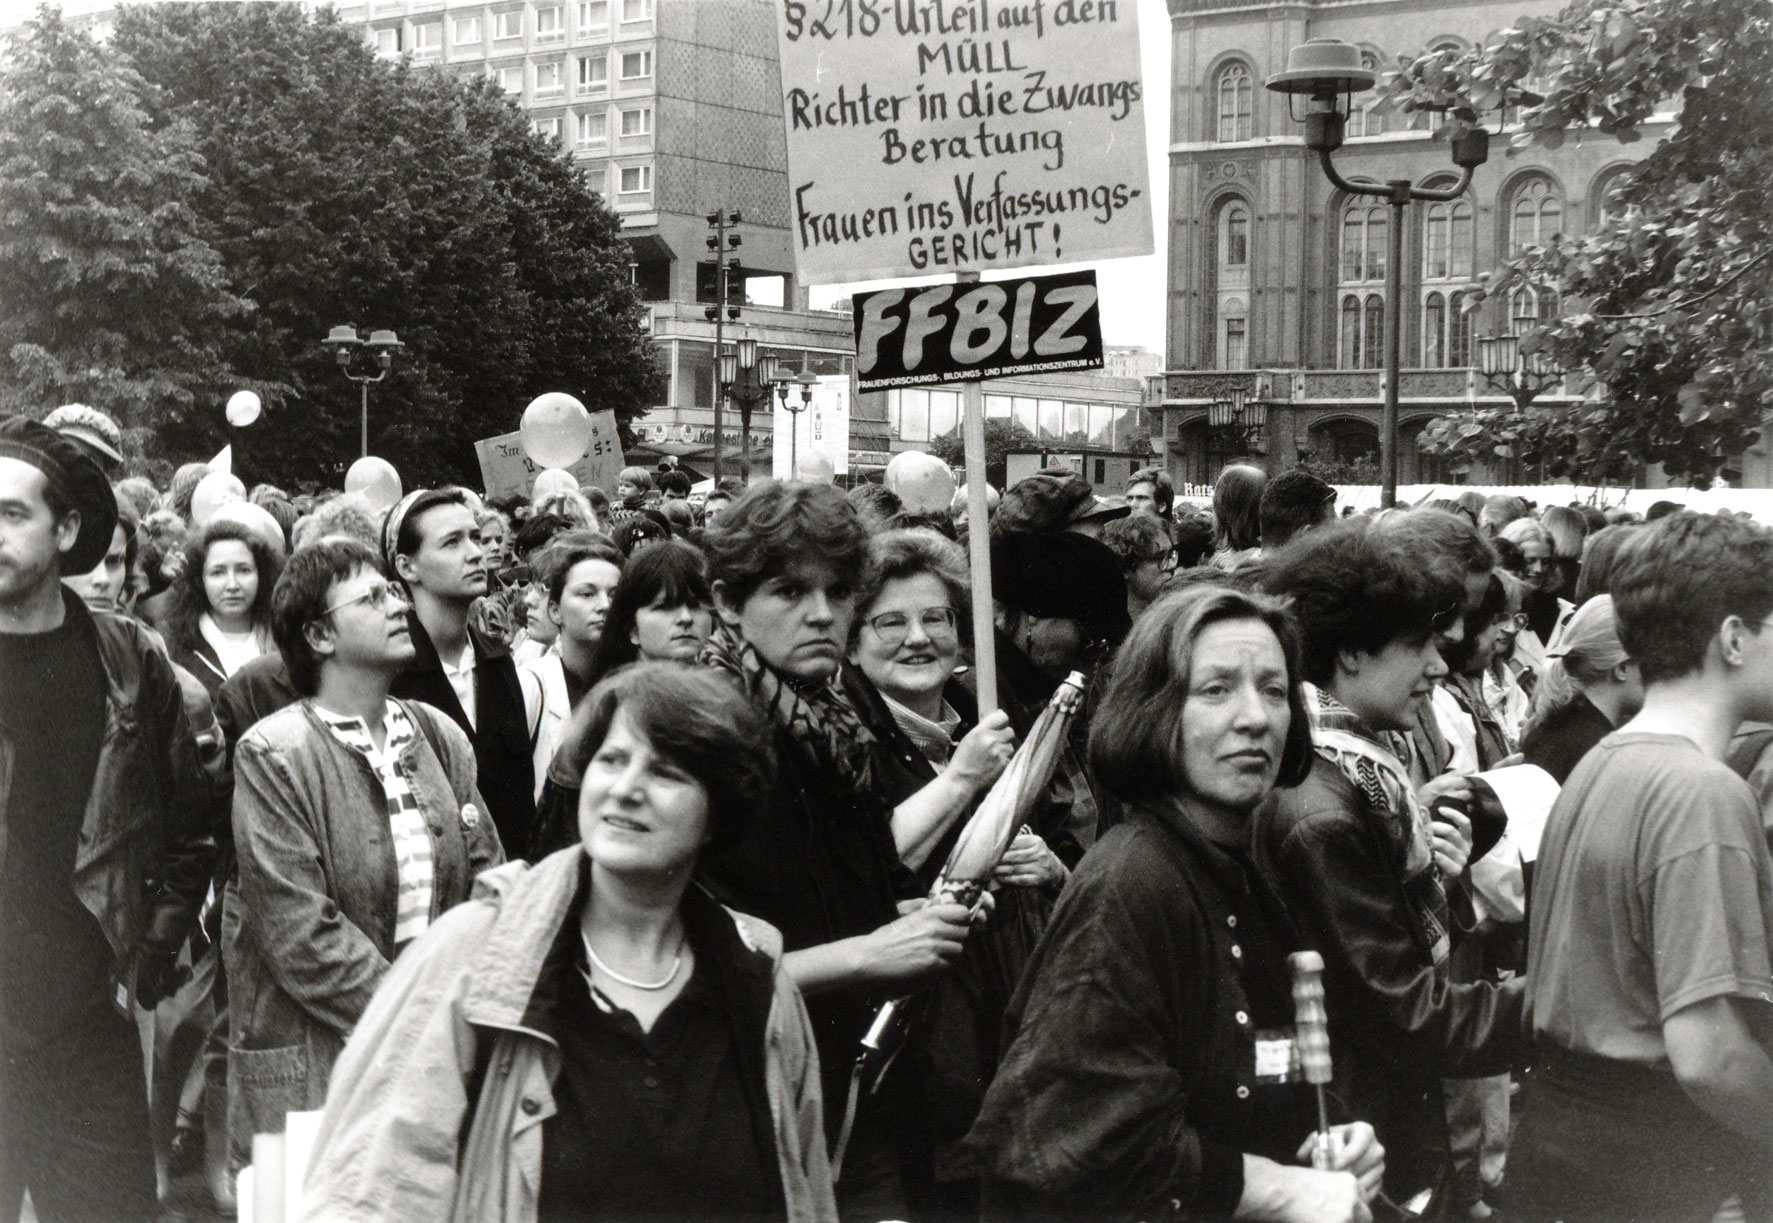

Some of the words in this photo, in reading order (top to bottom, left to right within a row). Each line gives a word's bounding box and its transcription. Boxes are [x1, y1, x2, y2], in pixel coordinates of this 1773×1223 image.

[998, 0, 1043, 38] auf
[1054, 0, 1117, 26] den
[918, 39, 1027, 75] MÜLL
[788, 84, 911, 130] Richter
[918, 85, 948, 121] in
[958, 79, 1018, 118] die
[1024, 71, 1140, 120] Zwangs
[882, 122, 1063, 170] Beratung
[796, 182, 897, 250] Frauen
[904, 193, 953, 229] ins
[954, 171, 1140, 232] Verfassungs-
[858, 281, 1097, 373] FFBIZ
[943, 369, 982, 381] BILDUNGS-
[984, 368, 1000, 376] UND
[1002, 359, 1087, 374] INFORMATIONSZENTRUM
